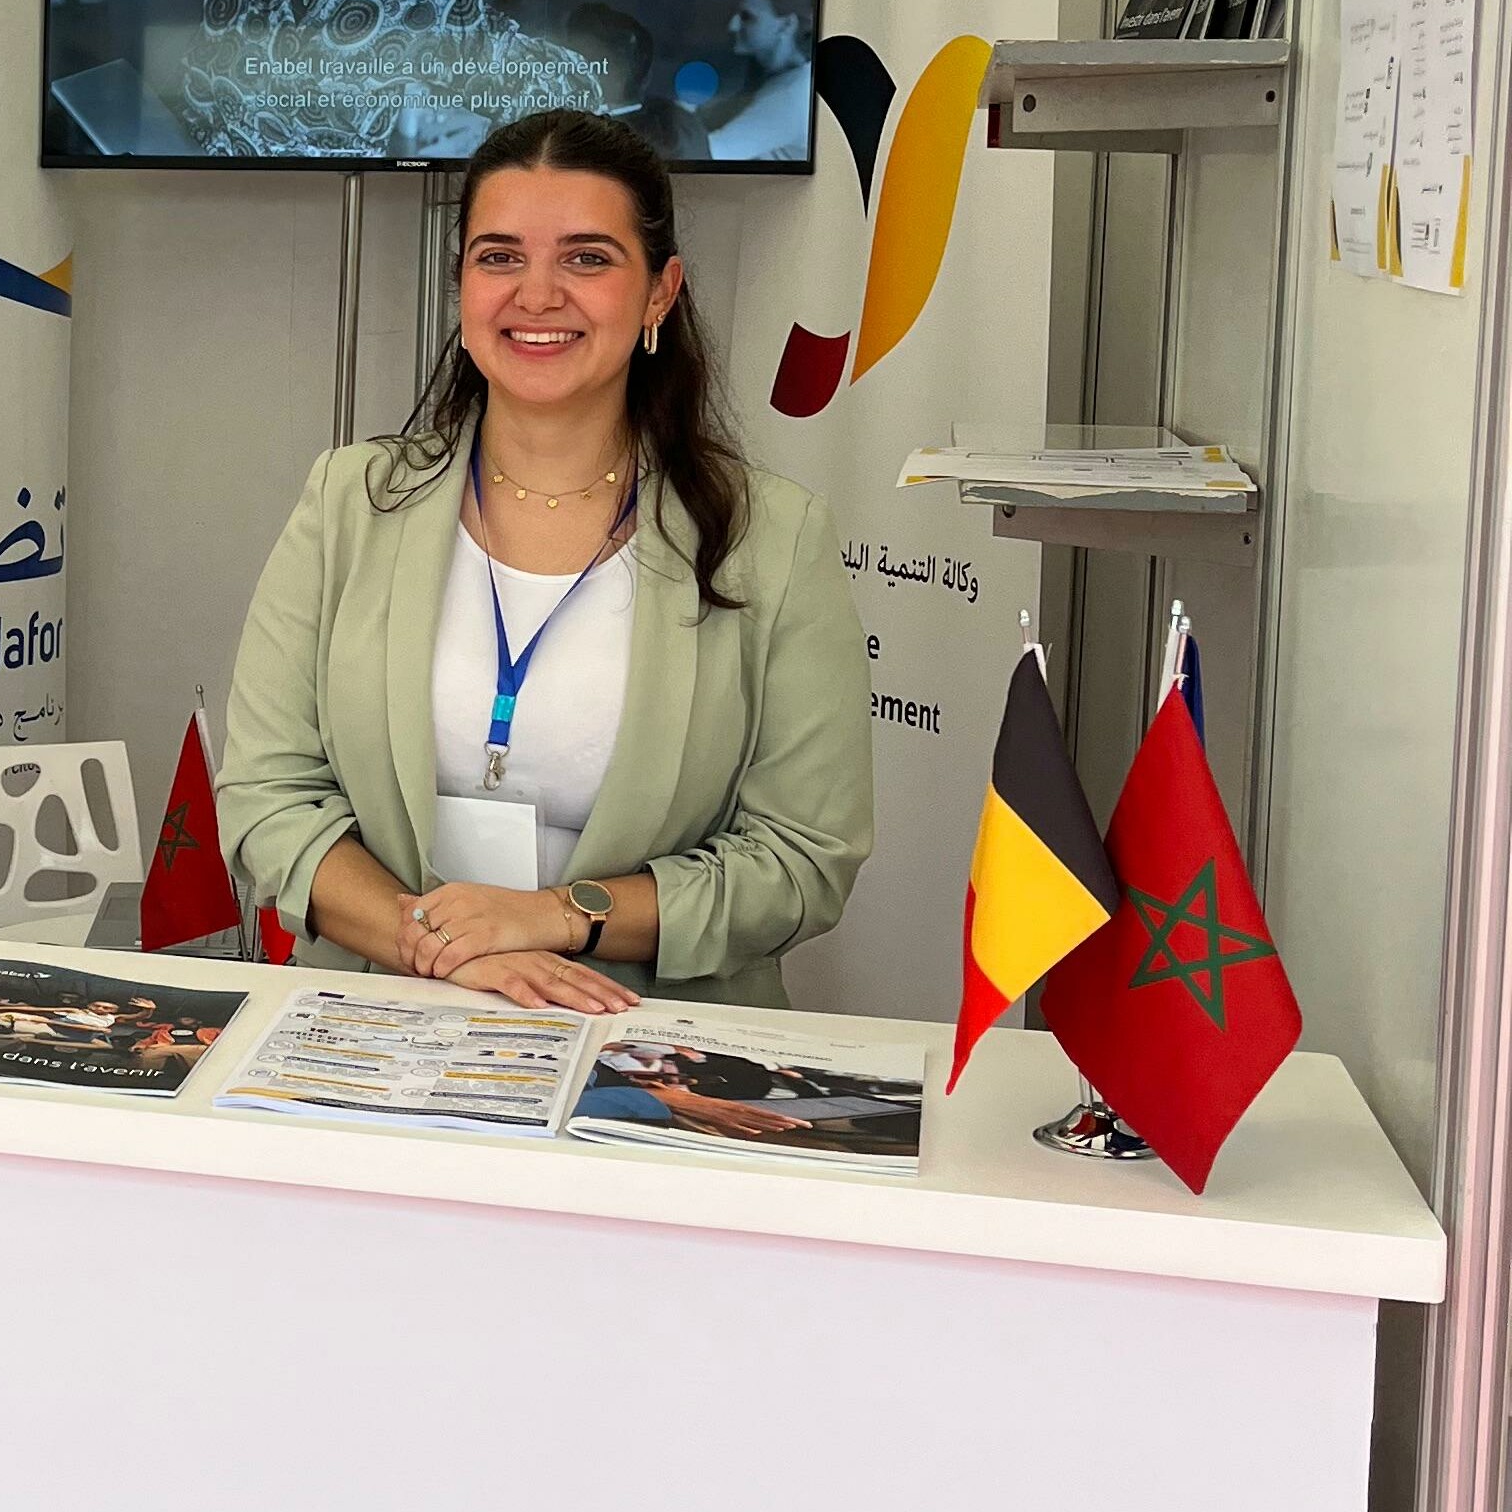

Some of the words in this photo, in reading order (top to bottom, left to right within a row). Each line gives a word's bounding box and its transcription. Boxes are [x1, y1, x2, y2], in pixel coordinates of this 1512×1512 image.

[245, 57, 312, 75] Enabel
[320, 57, 394, 75] travaille
[421, 61, 445, 75] un
[452, 56, 609, 79] développement
[256, 90, 311, 108] social
[318, 91, 336, 108] et
[342, 91, 464, 110] économique
[470, 90, 512, 110] plus
[877, 545, 936, 588] التنمية
[942, 557, 978, 604] وكالة
[2, 1051, 62, 1069] dans
[69, 1061, 165, 1078] l'avenir
[478, 1048, 559, 1061] 2024
